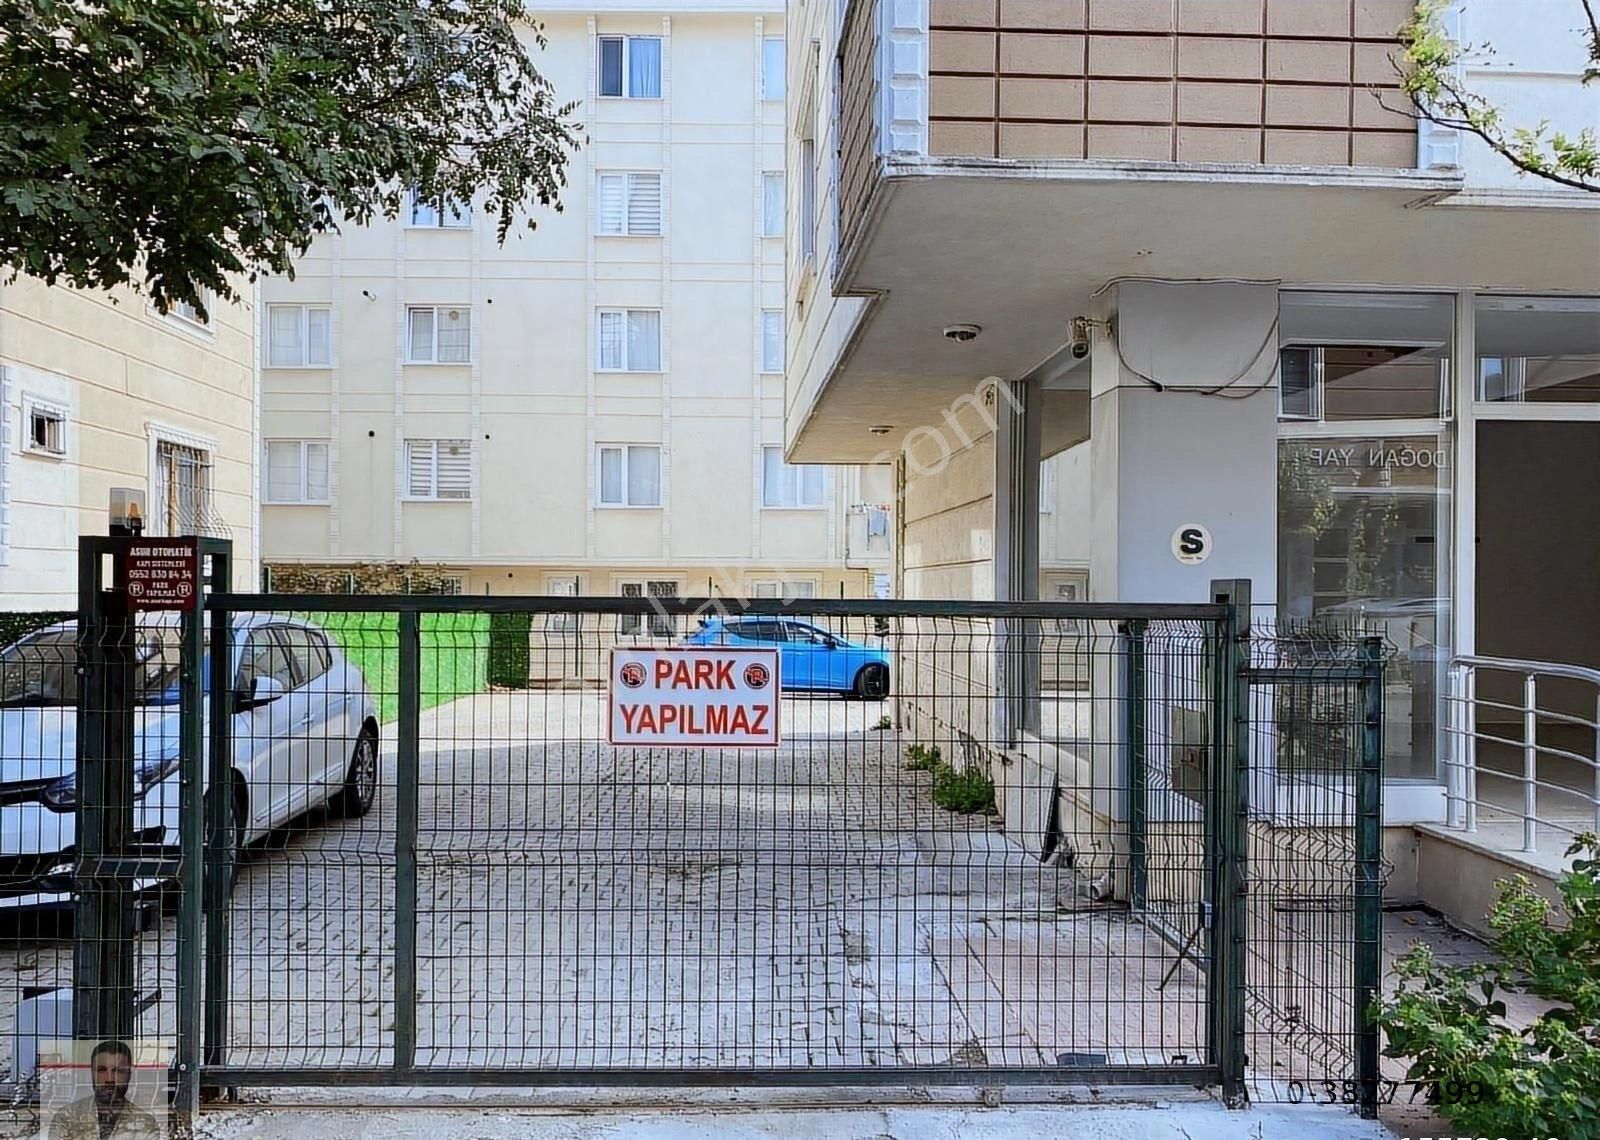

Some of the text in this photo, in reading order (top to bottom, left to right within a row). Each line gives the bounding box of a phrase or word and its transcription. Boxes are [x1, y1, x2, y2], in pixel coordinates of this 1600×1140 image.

[1180, 528, 1204, 554] S
[655, 659, 736, 690] PARK
[619, 704, 769, 735] YAPILMAZ
